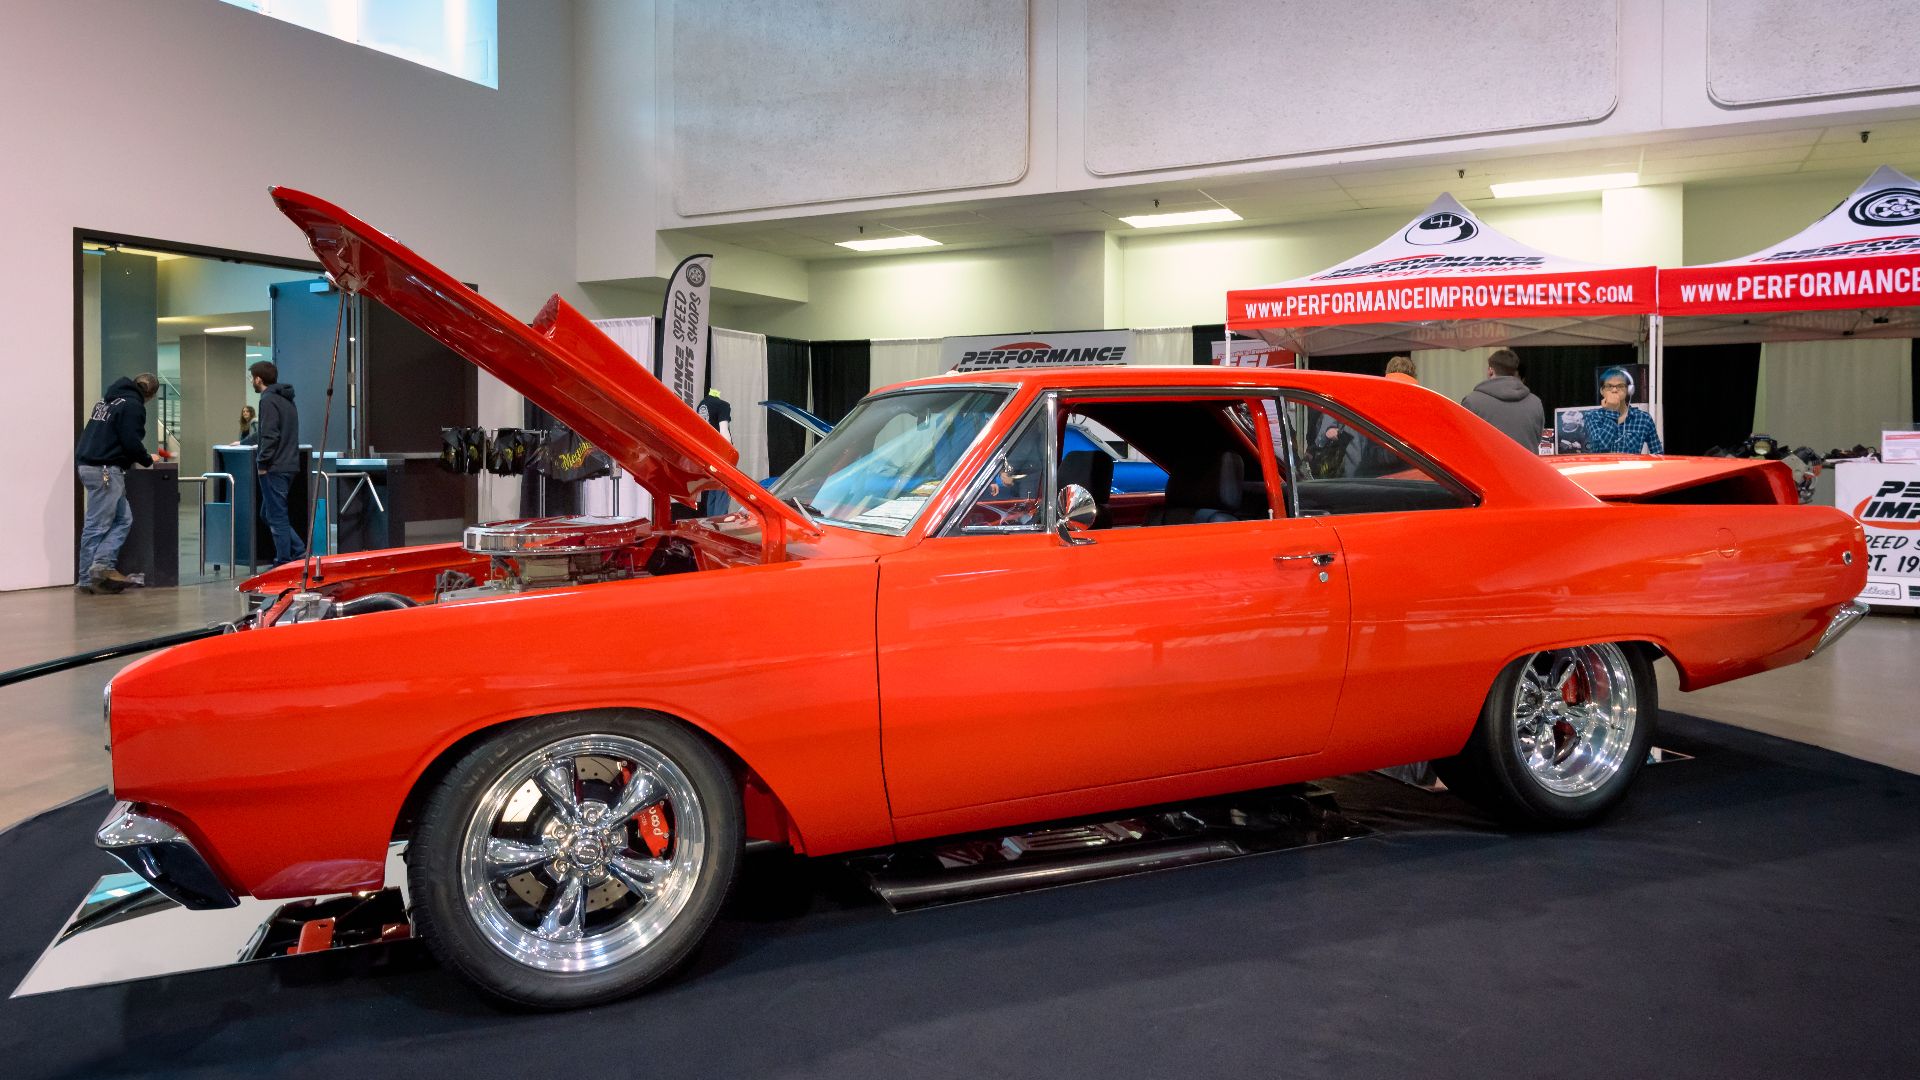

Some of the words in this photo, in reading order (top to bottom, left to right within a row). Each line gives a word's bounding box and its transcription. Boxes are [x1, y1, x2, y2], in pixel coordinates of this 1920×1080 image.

[673, 290, 687, 343] SPEED
[687, 291, 701, 345] SHOPS
[674, 344, 684, 401] ANCE
[960, 346, 1127, 365] PERFORMANCE
[1865, 535, 1909, 549] PEED
[1897, 555, 1920, 573] 19
